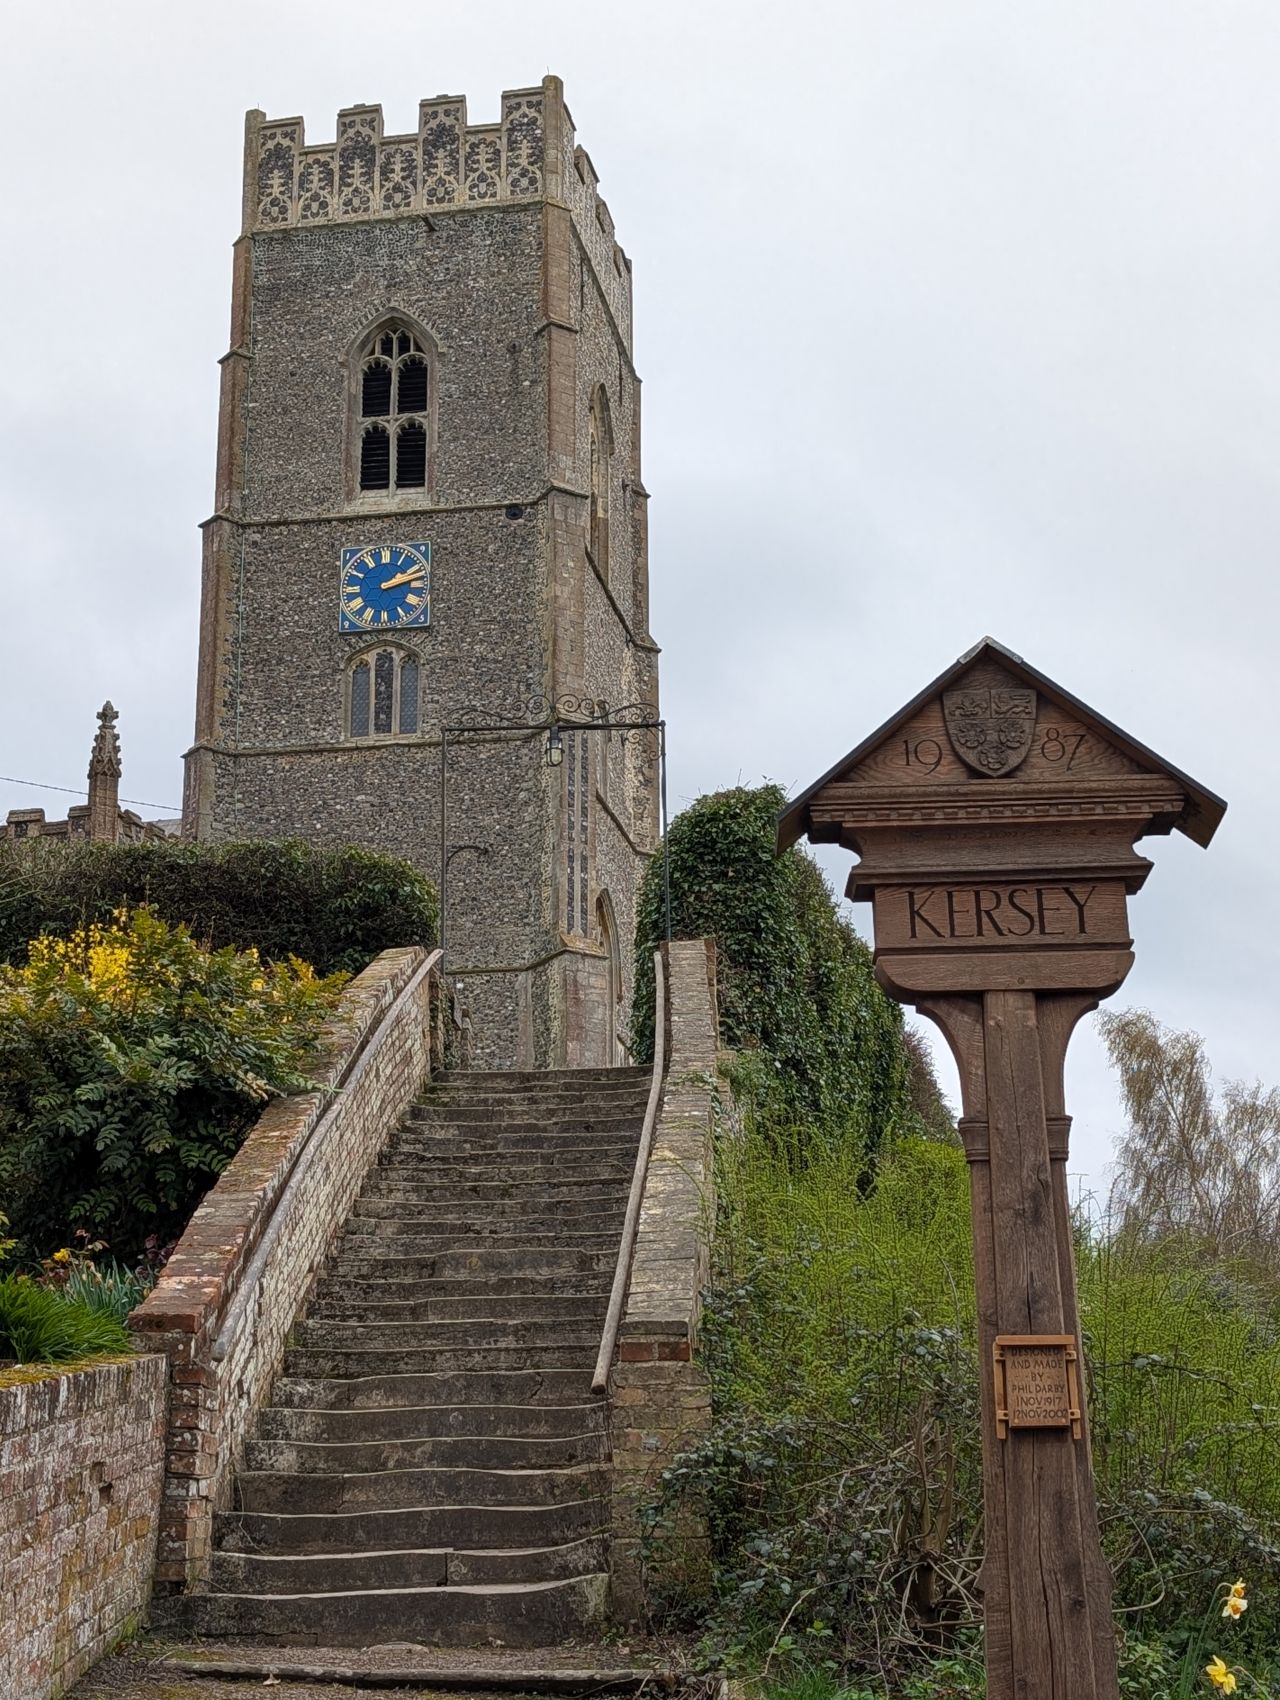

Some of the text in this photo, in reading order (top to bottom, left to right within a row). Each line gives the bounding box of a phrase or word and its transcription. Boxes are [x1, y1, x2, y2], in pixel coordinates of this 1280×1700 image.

[903, 727, 1087, 776] 19 87
[907, 885, 1097, 939] KERSEY
[1011, 1347, 1059, 1357] DESIGNED
[1010, 1359, 1064, 1369] AND MADE
[1030, 1372, 1044, 1382] BY
[1011, 1383, 1066, 1394] PHIL DARBY
